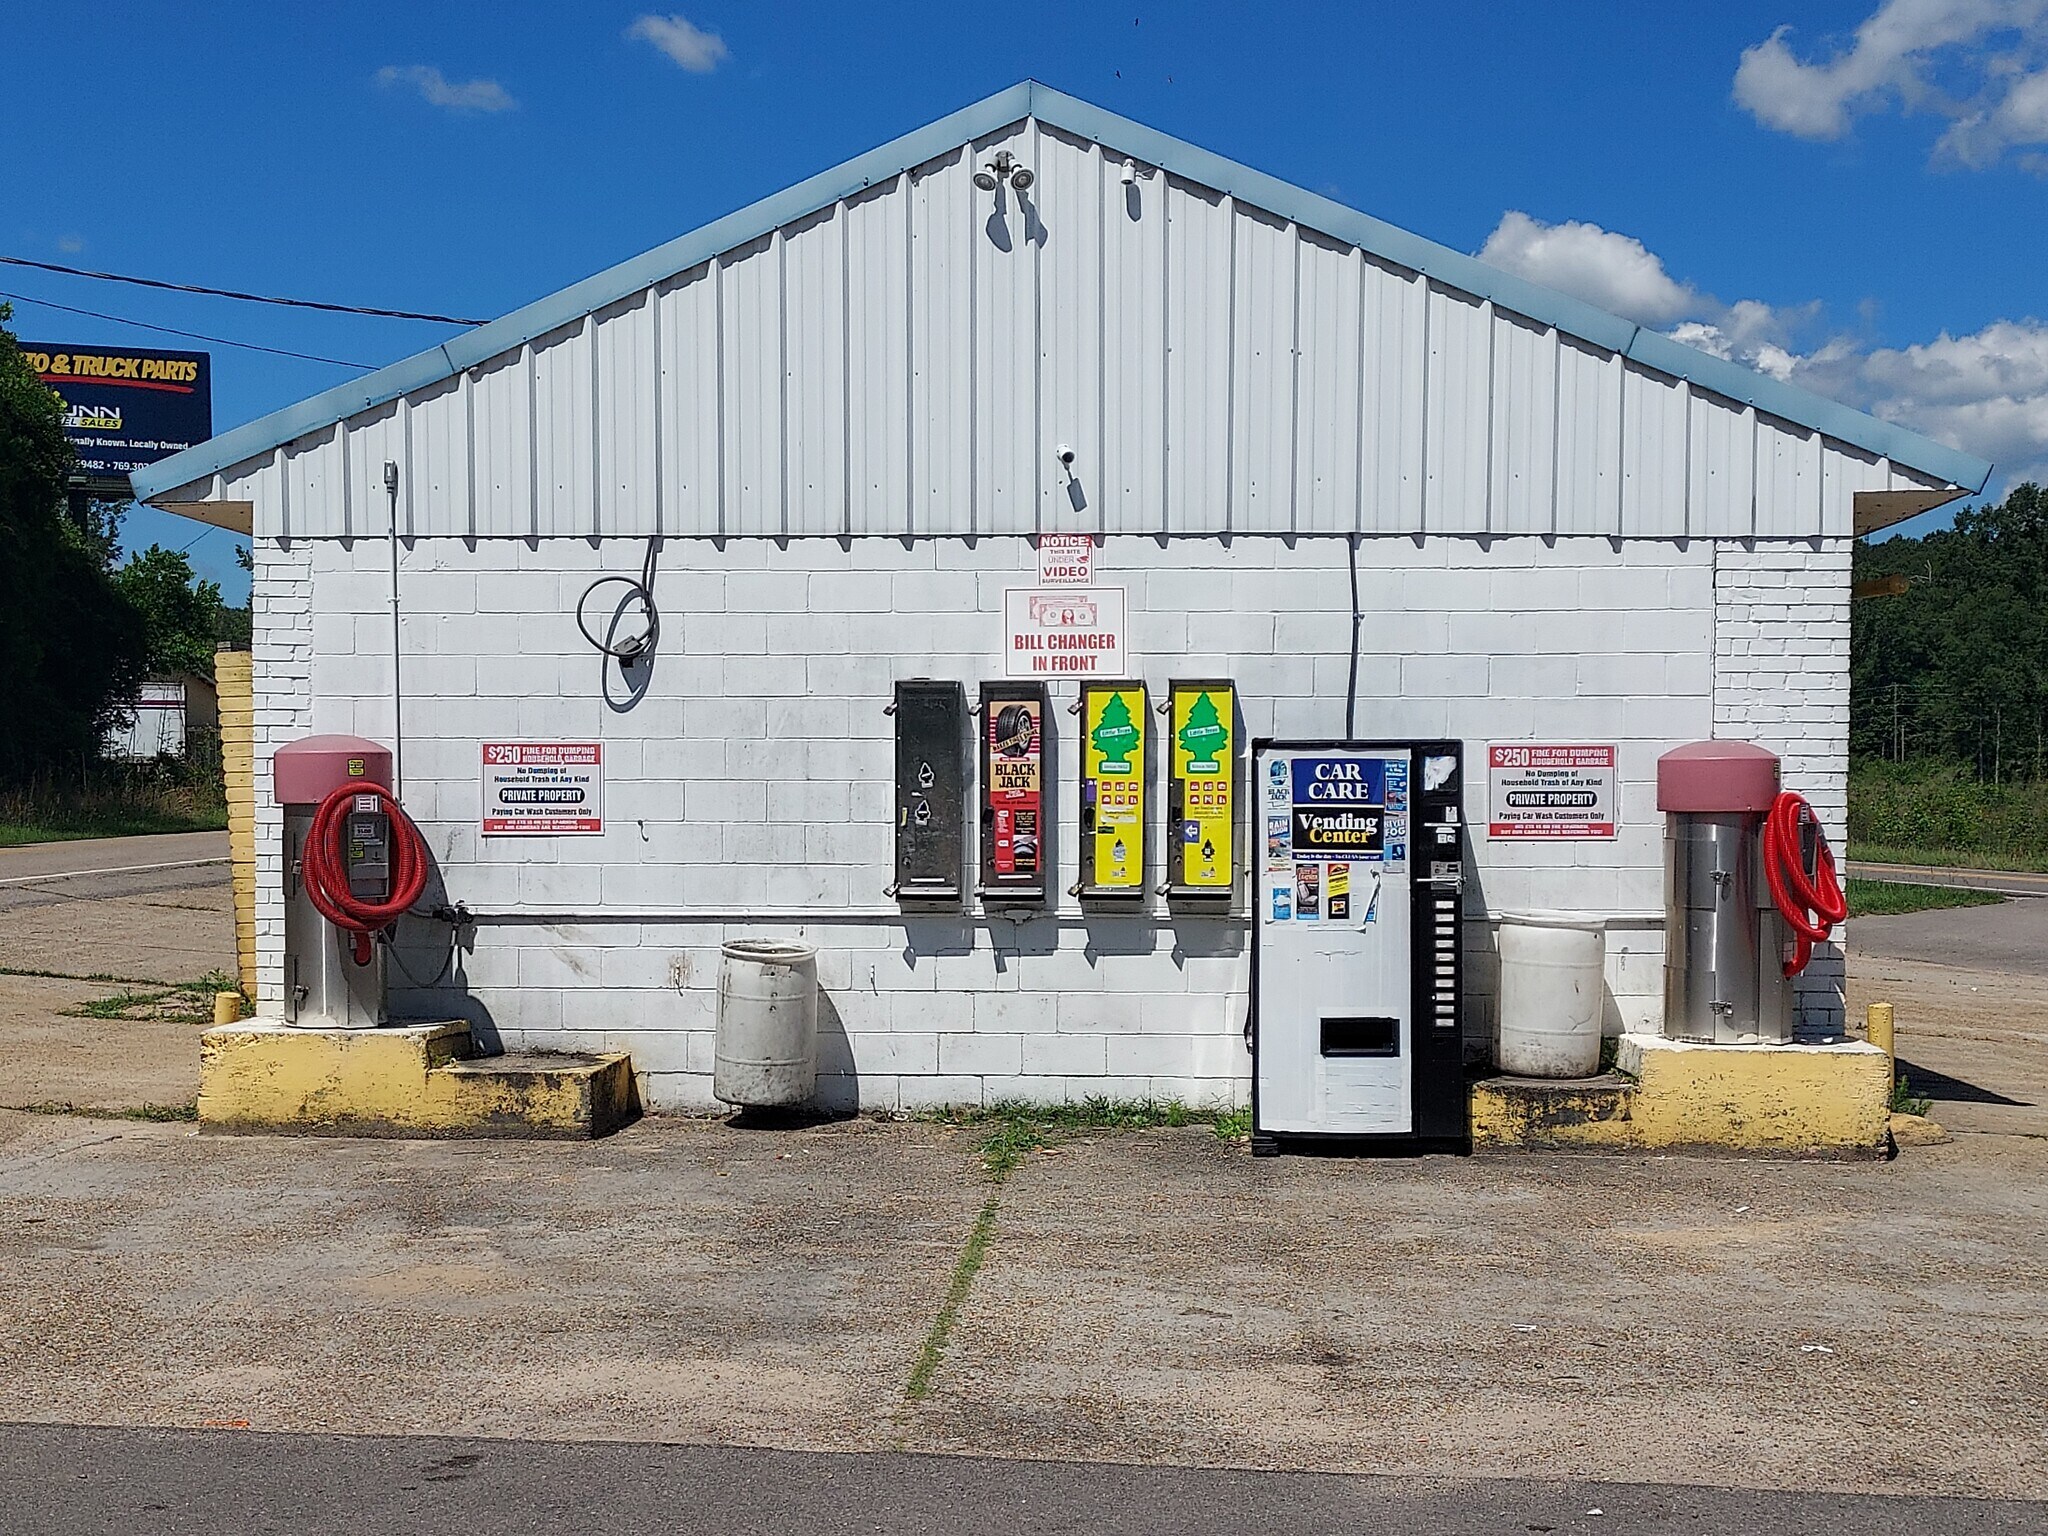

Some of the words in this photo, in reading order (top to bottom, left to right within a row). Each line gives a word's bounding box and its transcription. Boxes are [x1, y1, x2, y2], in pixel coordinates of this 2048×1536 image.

[25, 352, 50, 373] TO
[51, 354, 71, 374] &
[72, 355, 141, 379] TRUCK
[142, 359, 198, 382] PARTS
[80, 418, 119, 427] SALES
[96, 437, 128, 448] Known.
[129, 439, 158, 451] Locally
[76, 459, 104, 470] 9482
[1041, 535, 1087, 547] NOTICE
[1043, 566, 1088, 577] VIDEO
[1014, 634, 1044, 650] BILL
[1048, 634, 1116, 649] CHANGER
[1032, 656, 1047, 671] IN
[1051, 655, 1098, 671] FRONT
[488, 746, 520, 764] $250
[1495, 748, 1530, 766] $250
[1531, 749, 1550, 757] FINE
[1552, 749, 1568, 757] FOR
[1569, 749, 1608, 757] DUMPING
[522, 755, 562, 763] HOUSEHOLD
[1531, 757, 1574, 765] HOUSEHOLD
[528, 767, 558, 775] Dumping
[994, 763, 1036, 776] BLACK
[1315, 763, 1362, 781] CAR
[1537, 770, 1570, 778] Dumping
[560, 776, 572, 784] Any
[998, 776, 1031, 788] JACK
[1570, 779, 1584, 787] Any
[502, 790, 536, 801] PRIVATE
[538, 790, 582, 801] PROPERTY
[1308, 782, 1369, 799] CARE
[1509, 793, 1546, 805] PRIVATE
[1547, 793, 1594, 805] PROPERTY
[492, 808, 512, 816] Paying
[578, 808, 592, 816] Only
[1499, 812, 1521, 820] Paying
[1590, 812, 1605, 820] Only
[1268, 818, 1288, 828] RAIN
[1298, 813, 1379, 835] Vending
[1309, 827, 1370, 844] Center
